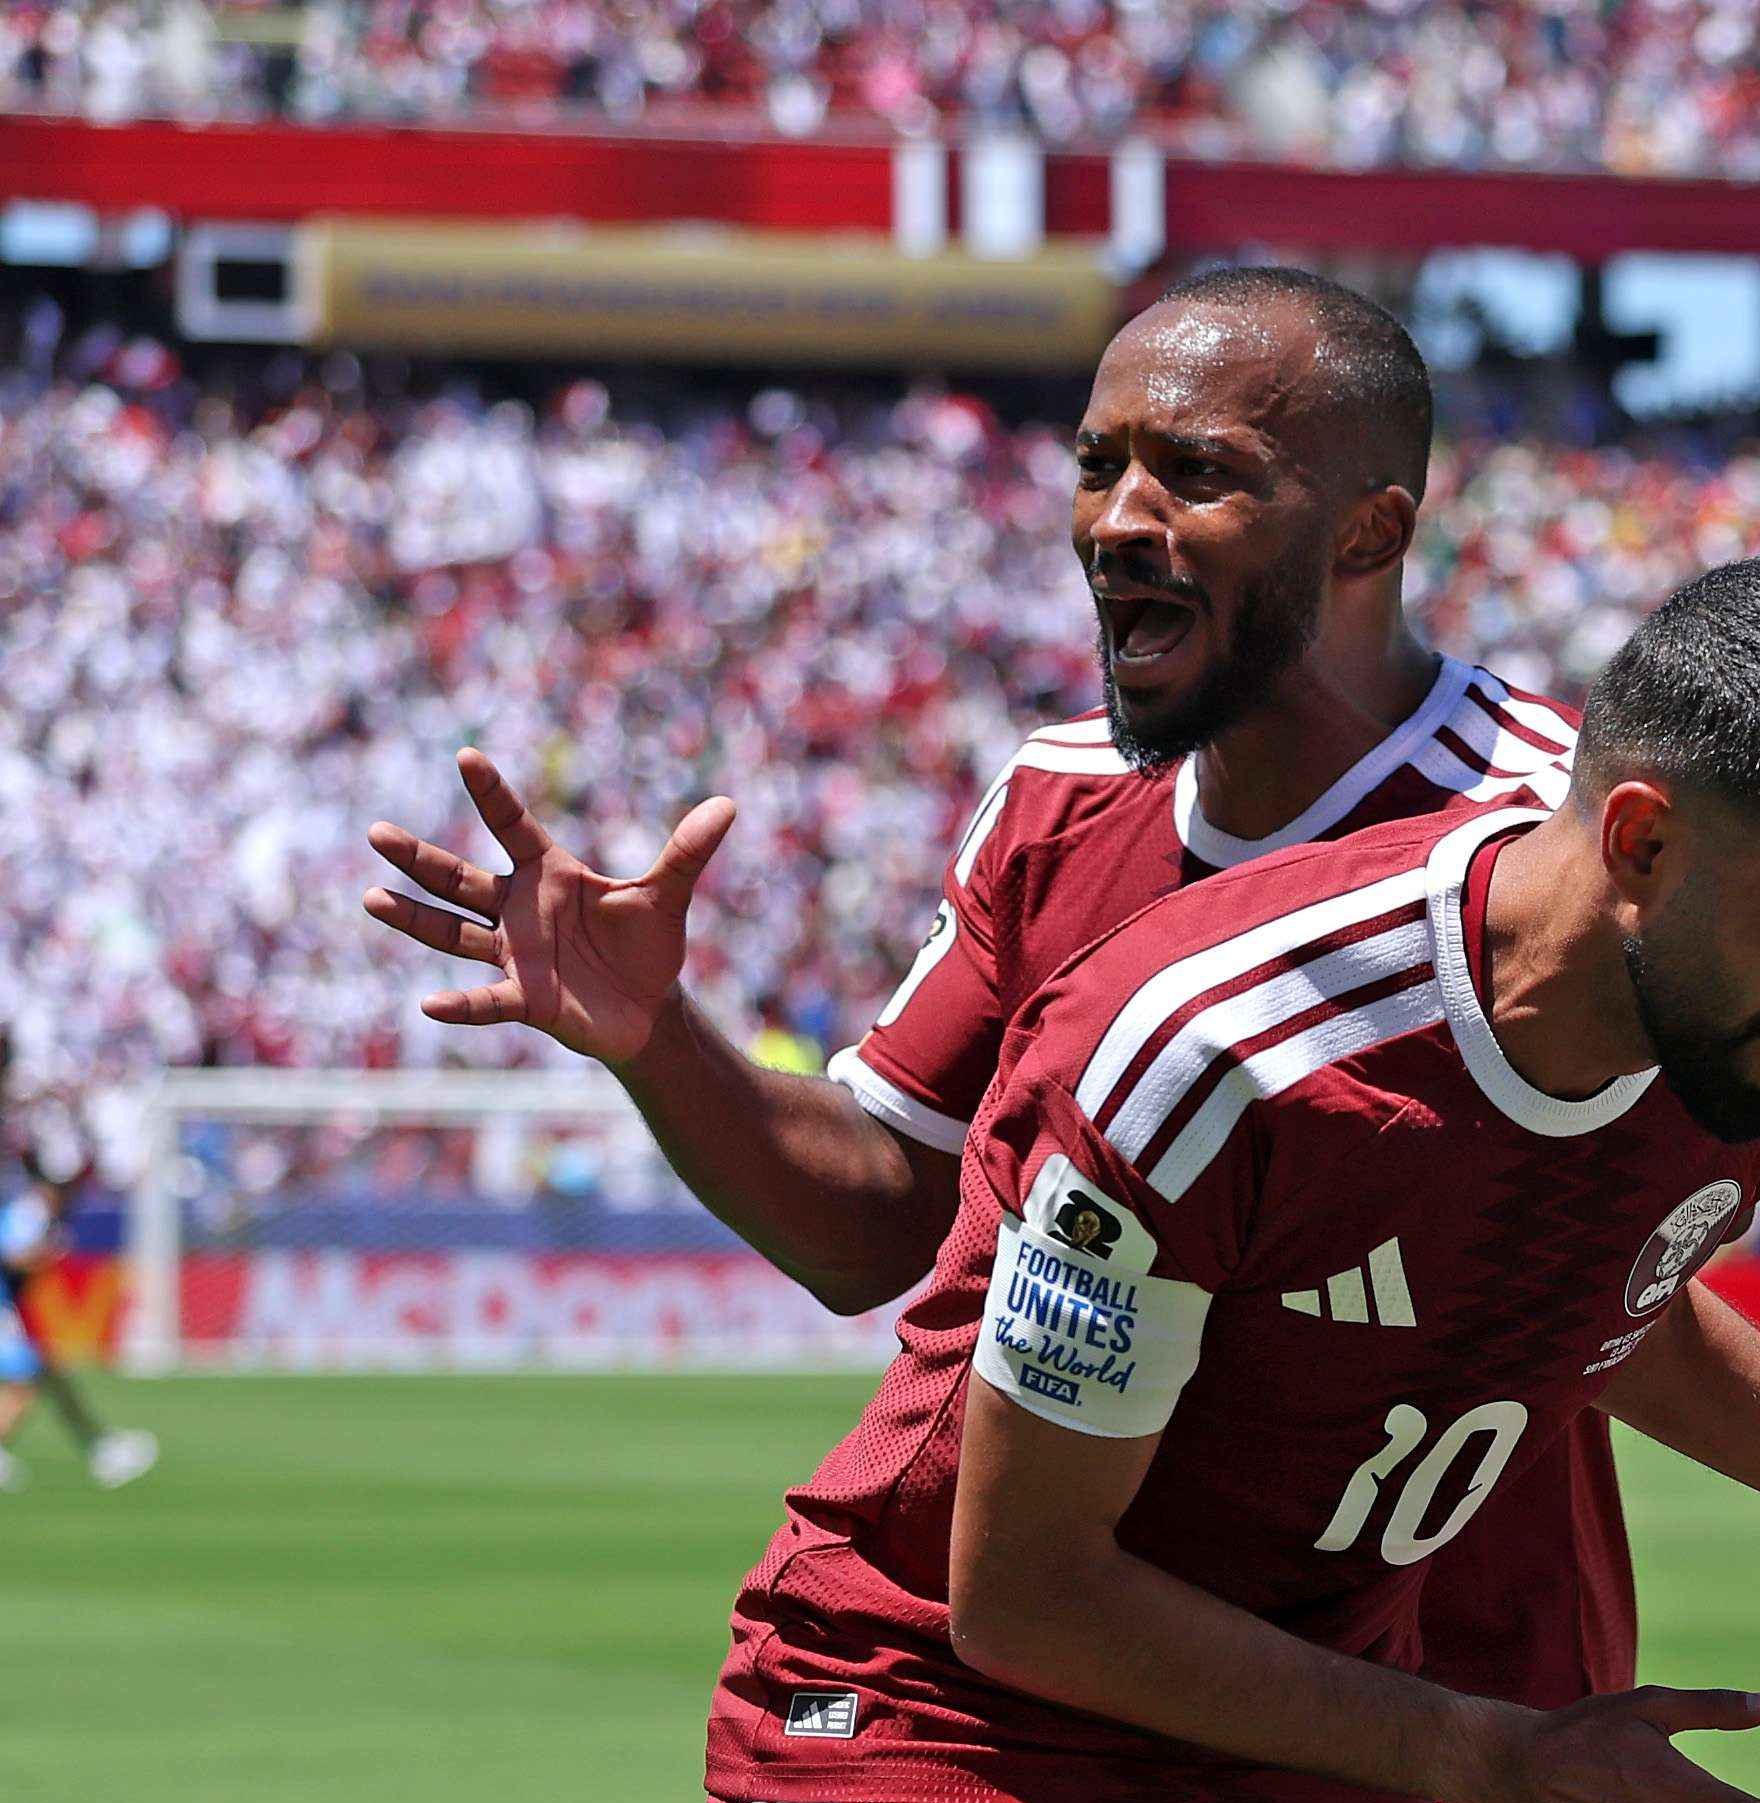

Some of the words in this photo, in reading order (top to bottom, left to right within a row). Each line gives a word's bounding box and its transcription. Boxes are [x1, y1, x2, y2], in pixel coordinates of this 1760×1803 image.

[1007, 1272, 1135, 1354] UNITES
[1017, 1241, 1138, 1313] FOOTBALL
[995, 1315, 1032, 1355] the
[1036, 1334, 1136, 1394] World
[1024, 1366, 1075, 1401] FIFA
[1314, 1401, 1528, 1565] 10
